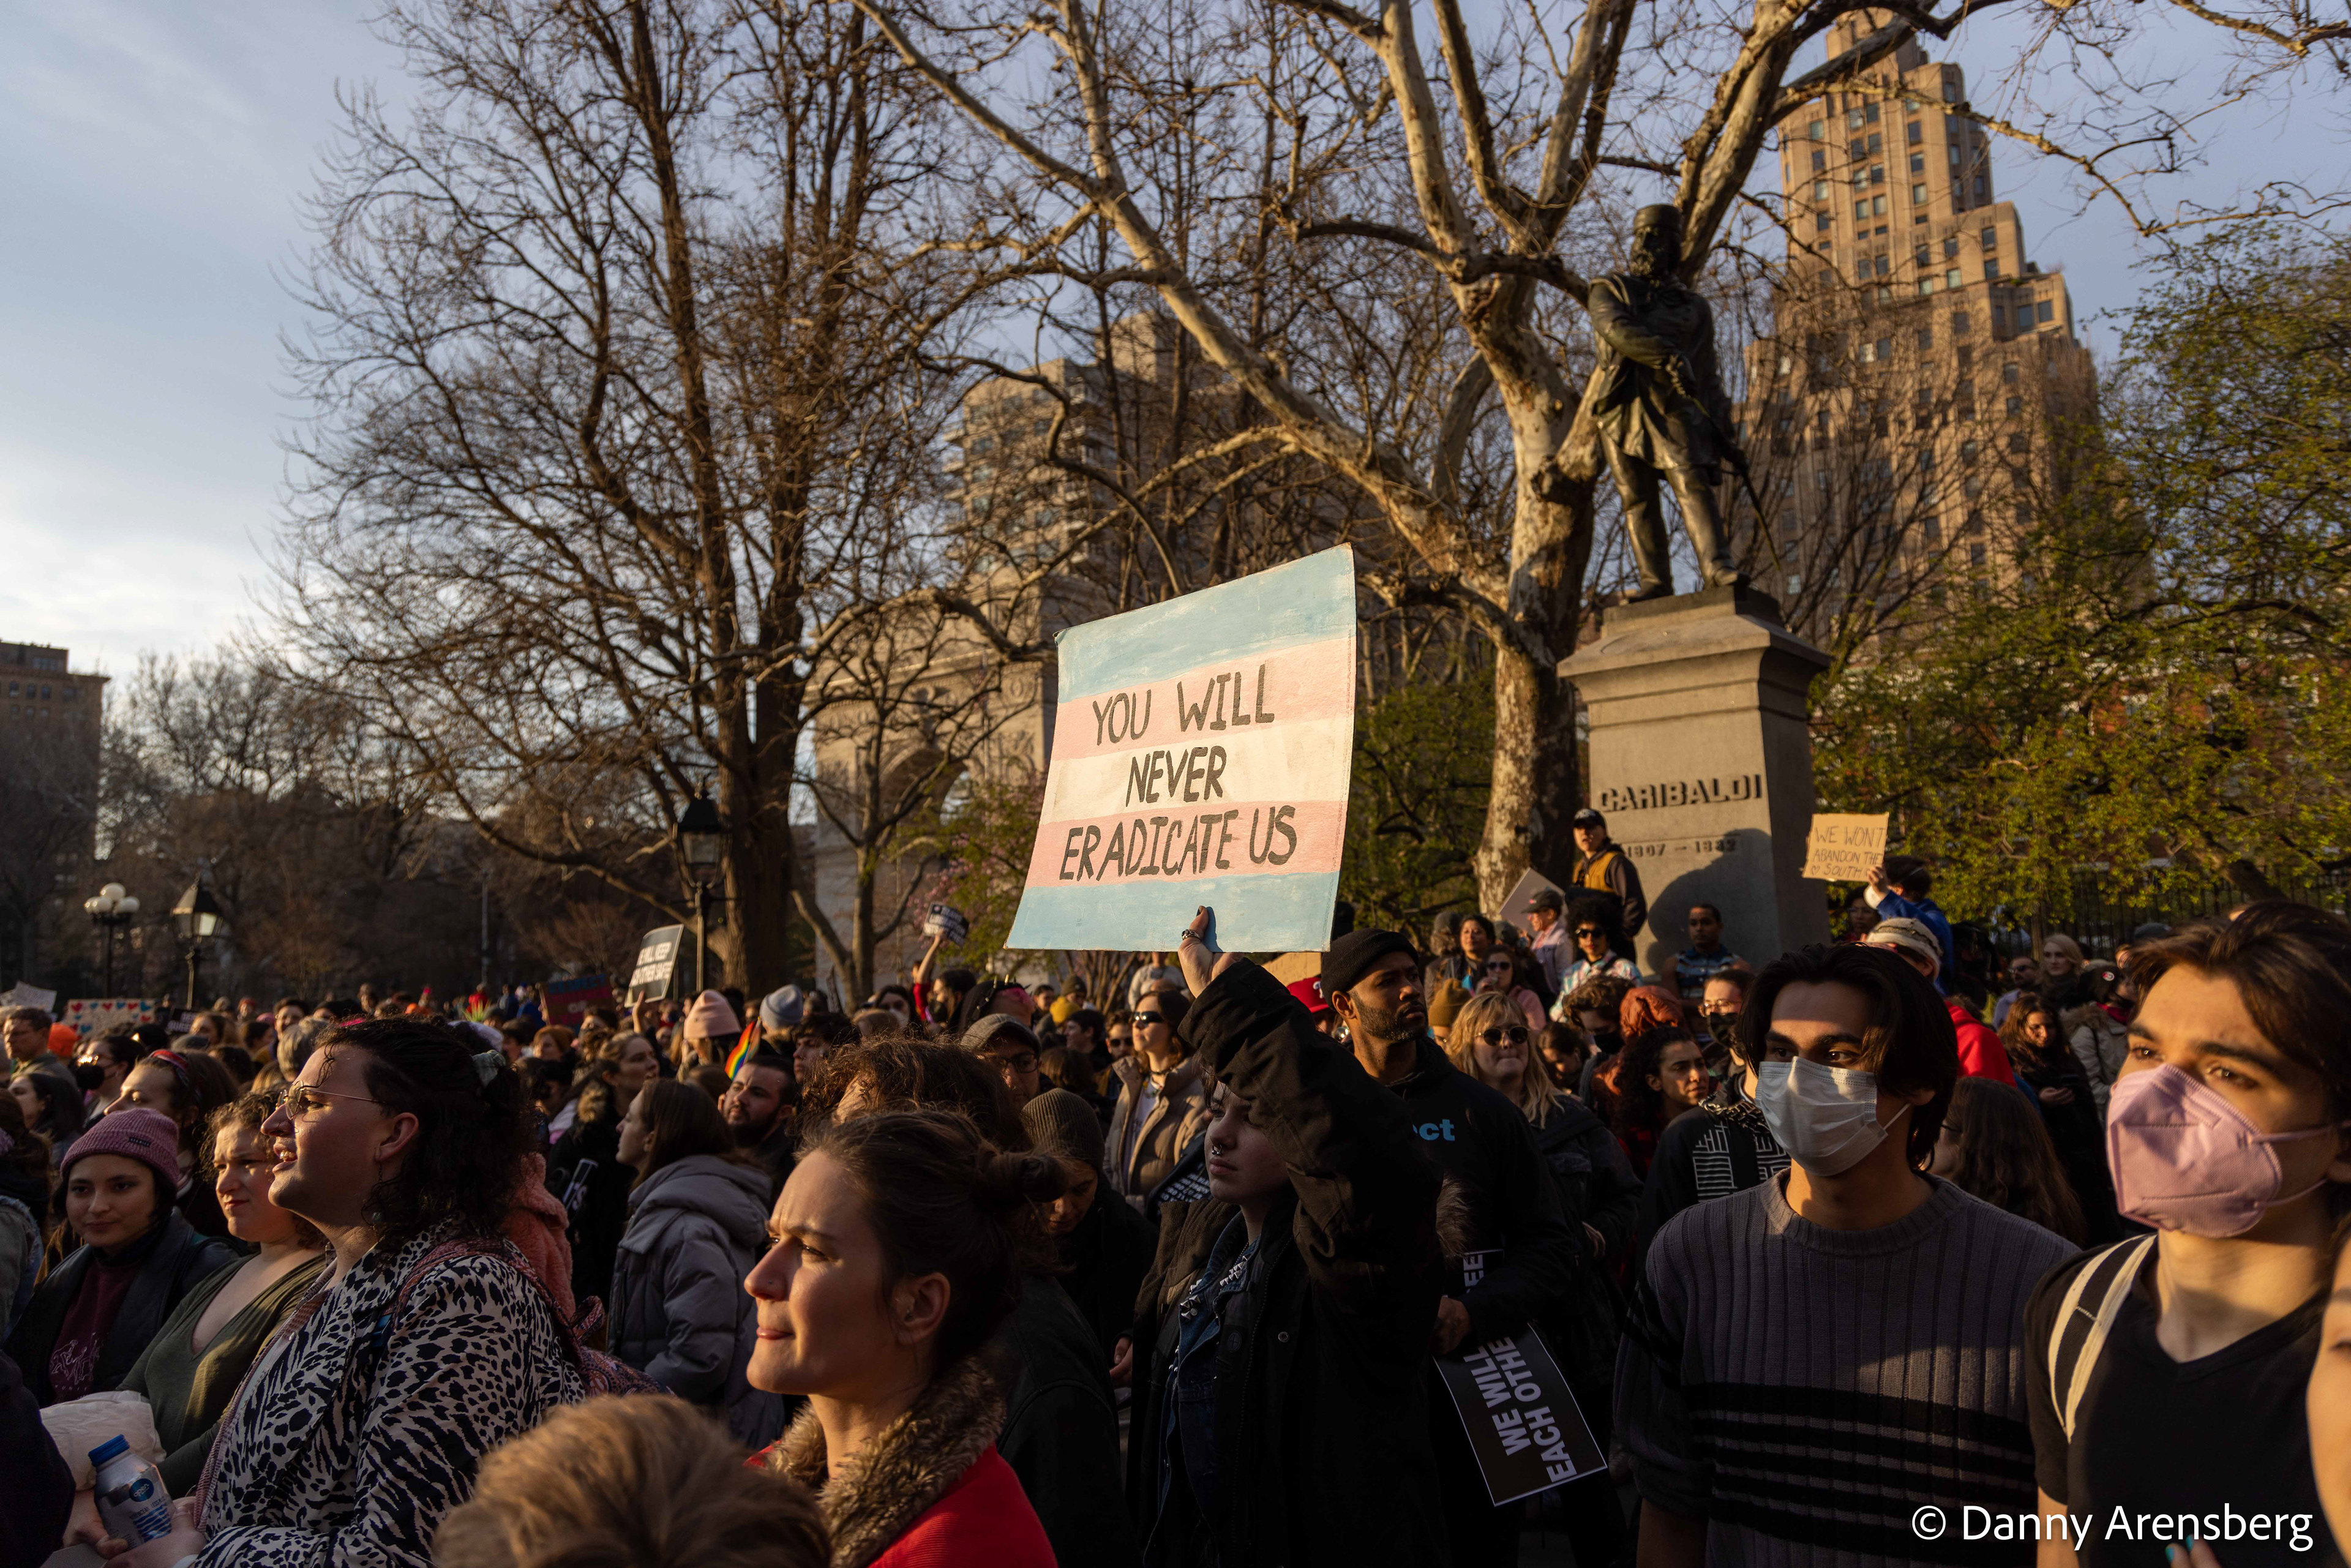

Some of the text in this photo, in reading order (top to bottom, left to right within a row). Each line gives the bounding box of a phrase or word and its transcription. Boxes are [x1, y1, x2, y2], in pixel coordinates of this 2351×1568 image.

[1092, 664, 1274, 746] YOU WILL
[1125, 745, 1226, 807] NEVER
[1599, 774, 1762, 812] GARIBALDI
[1059, 805, 1297, 882] ERADICATE US
[1813, 849, 1883, 865] ABANDON THE
[1815, 825, 1839, 843] WE
[1824, 864, 1862, 878] SOUTH
[1463, 1346, 1531, 1456] WE WILL
[1487, 1337, 1577, 1482] EACH OTHE
[133, 1484, 149, 1497] open
